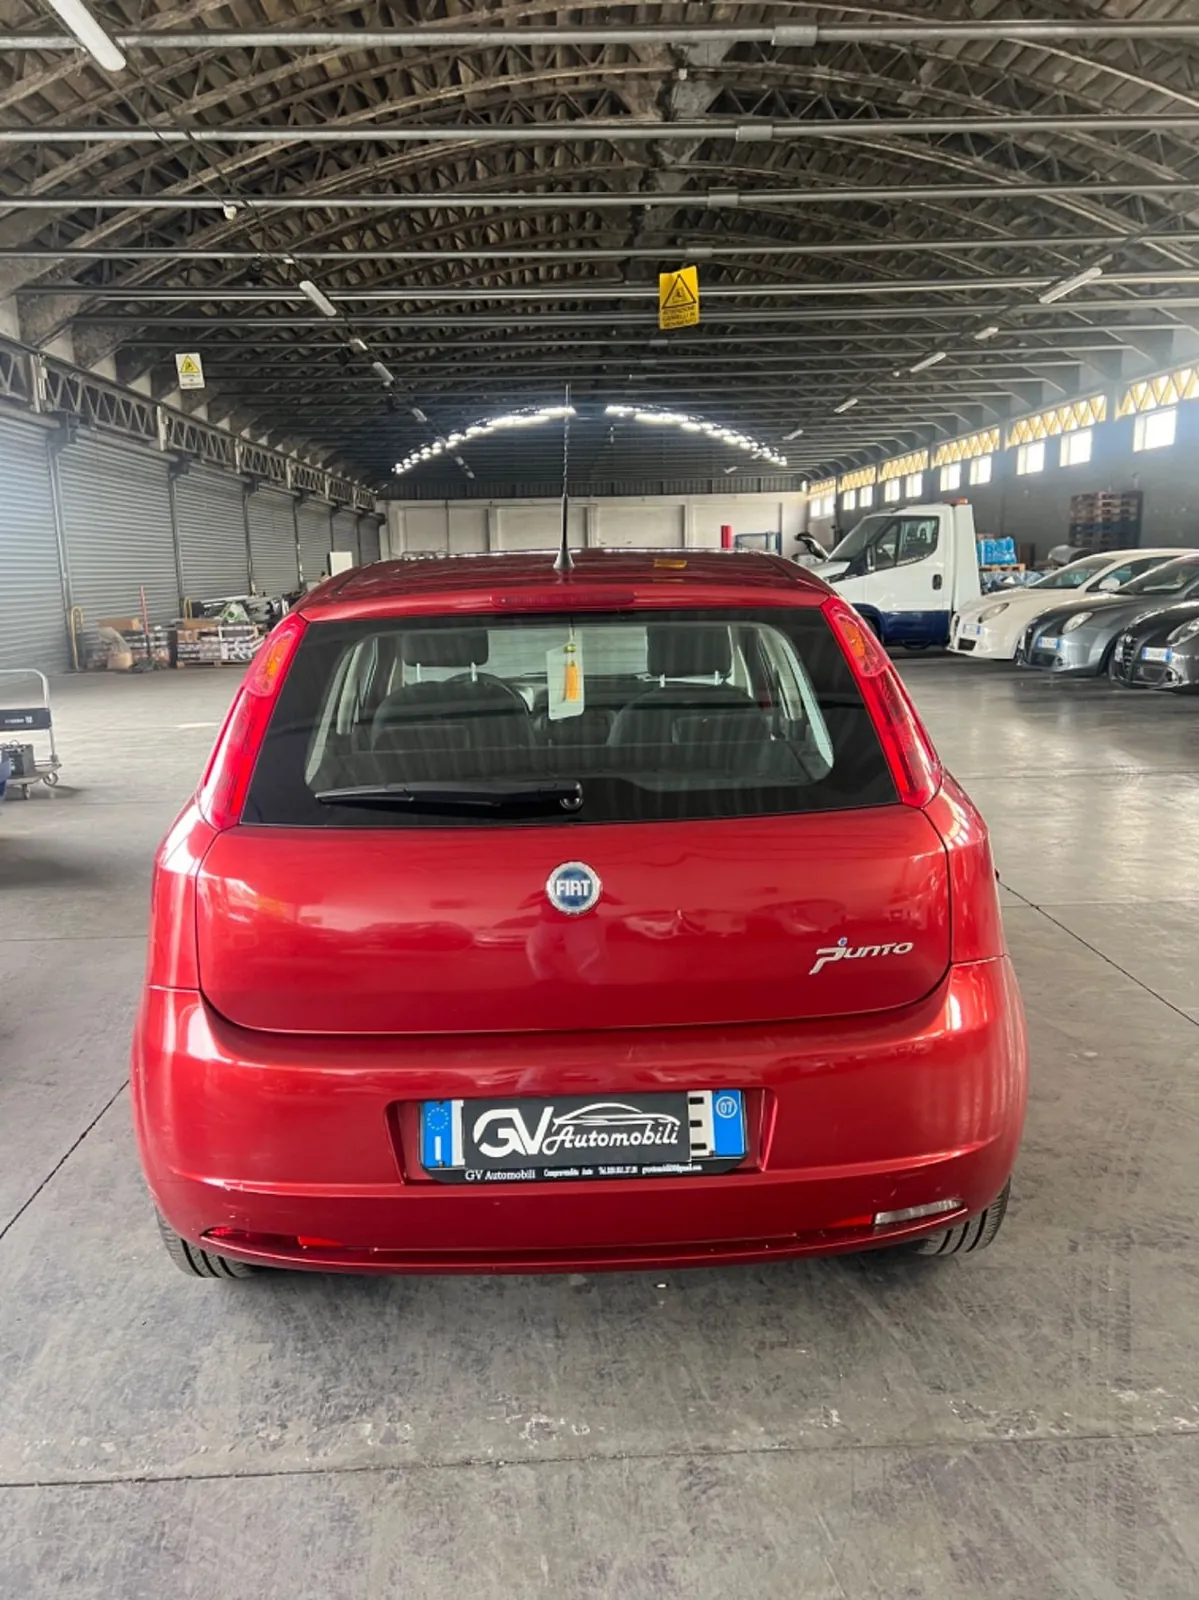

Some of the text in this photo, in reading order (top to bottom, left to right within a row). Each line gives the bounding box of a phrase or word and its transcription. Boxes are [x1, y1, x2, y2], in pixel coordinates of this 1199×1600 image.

[556, 880, 591, 896] FIAT
[720, 1101, 732, 1114] 07
[473, 1106, 680, 1158] GV Automobili
[465, 1170, 483, 1181] GV
[485, 1169, 536, 1180] Automobili
